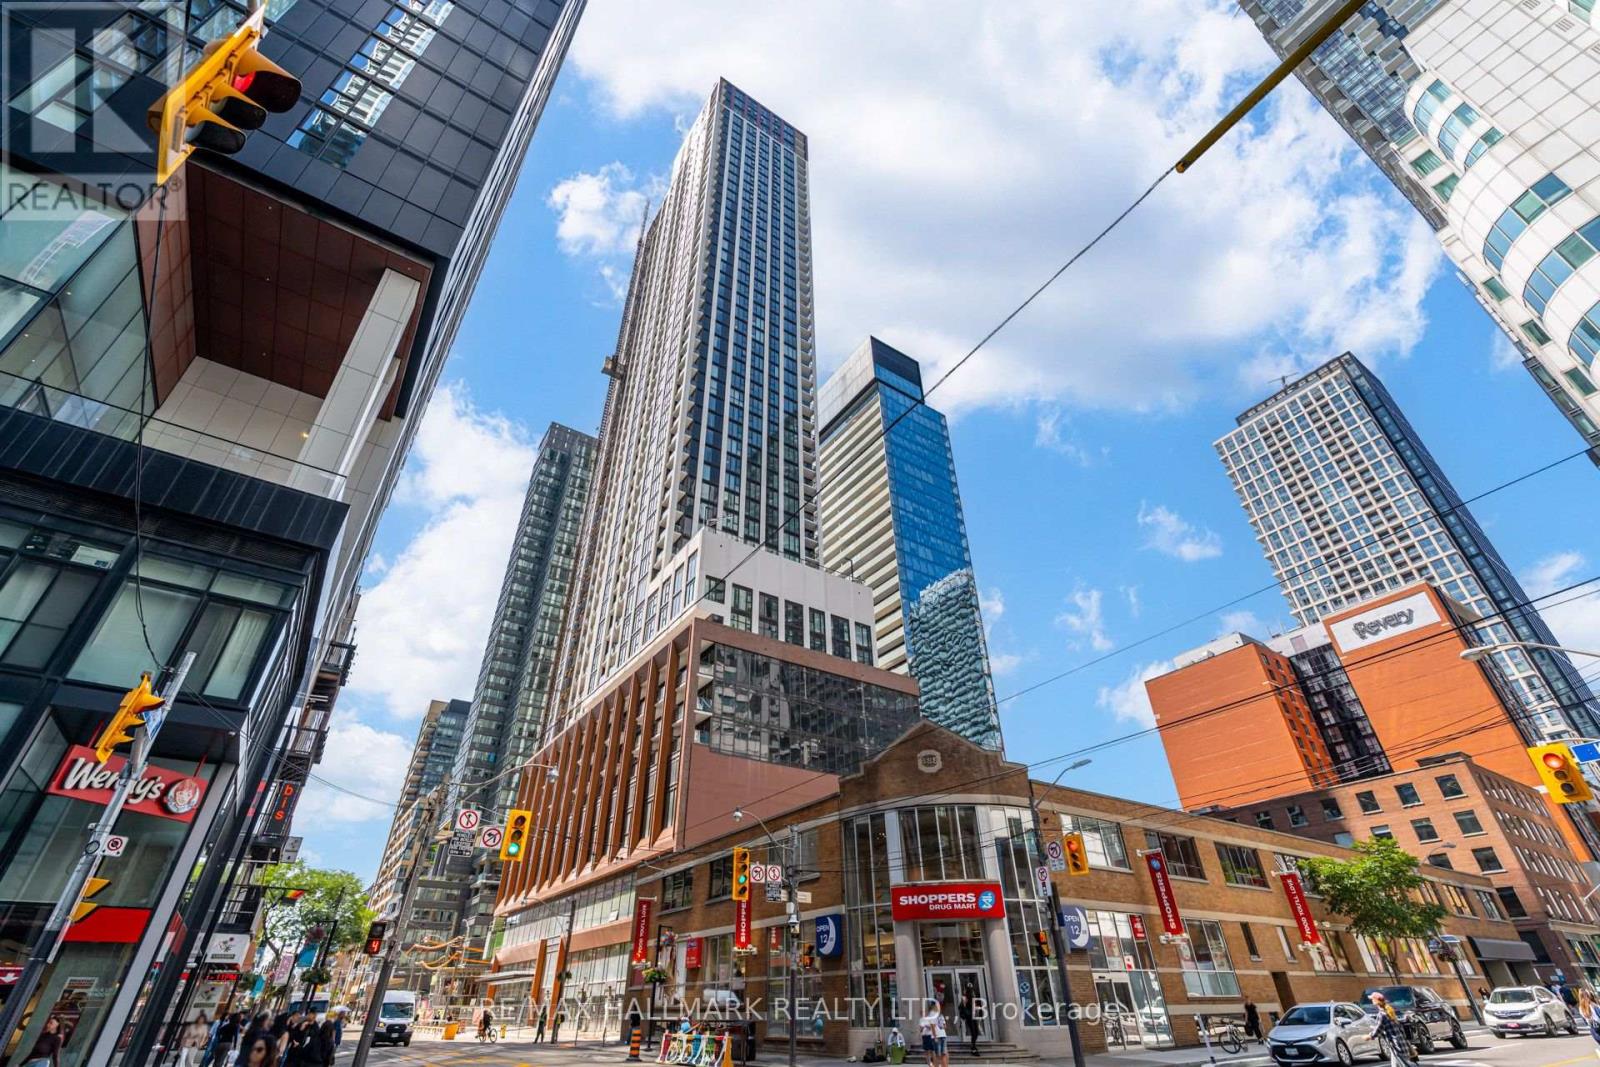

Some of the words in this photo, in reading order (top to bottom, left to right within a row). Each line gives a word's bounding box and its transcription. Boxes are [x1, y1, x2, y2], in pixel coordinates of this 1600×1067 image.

[899, 892, 976, 905] SHOPPERS
[1155, 872, 1177, 930] SHOPPERS
[929, 903, 952, 911] DRUG
[1064, 914, 1080, 923] OPEN
[816, 923, 830, 933] OPEN
[1070, 925, 1080, 935] 12
